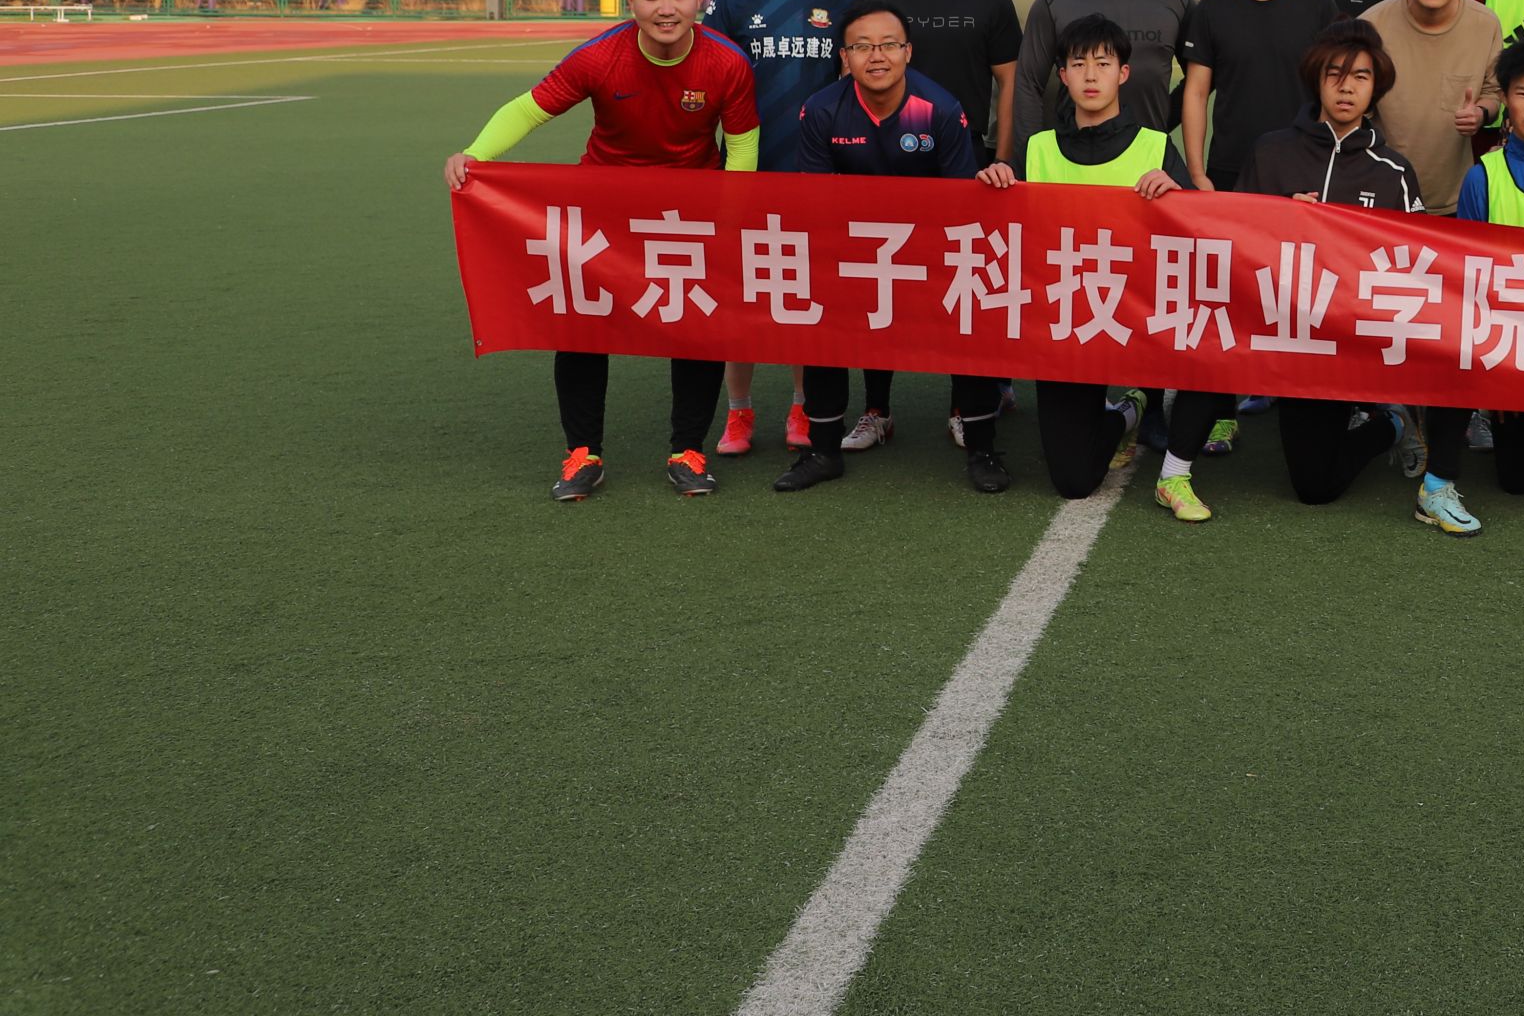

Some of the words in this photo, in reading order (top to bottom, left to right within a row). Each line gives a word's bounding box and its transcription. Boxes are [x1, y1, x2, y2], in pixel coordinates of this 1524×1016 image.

[906, 16, 975, 28] PYDER
[750, 36, 833, 60] 中晟卓远建设
